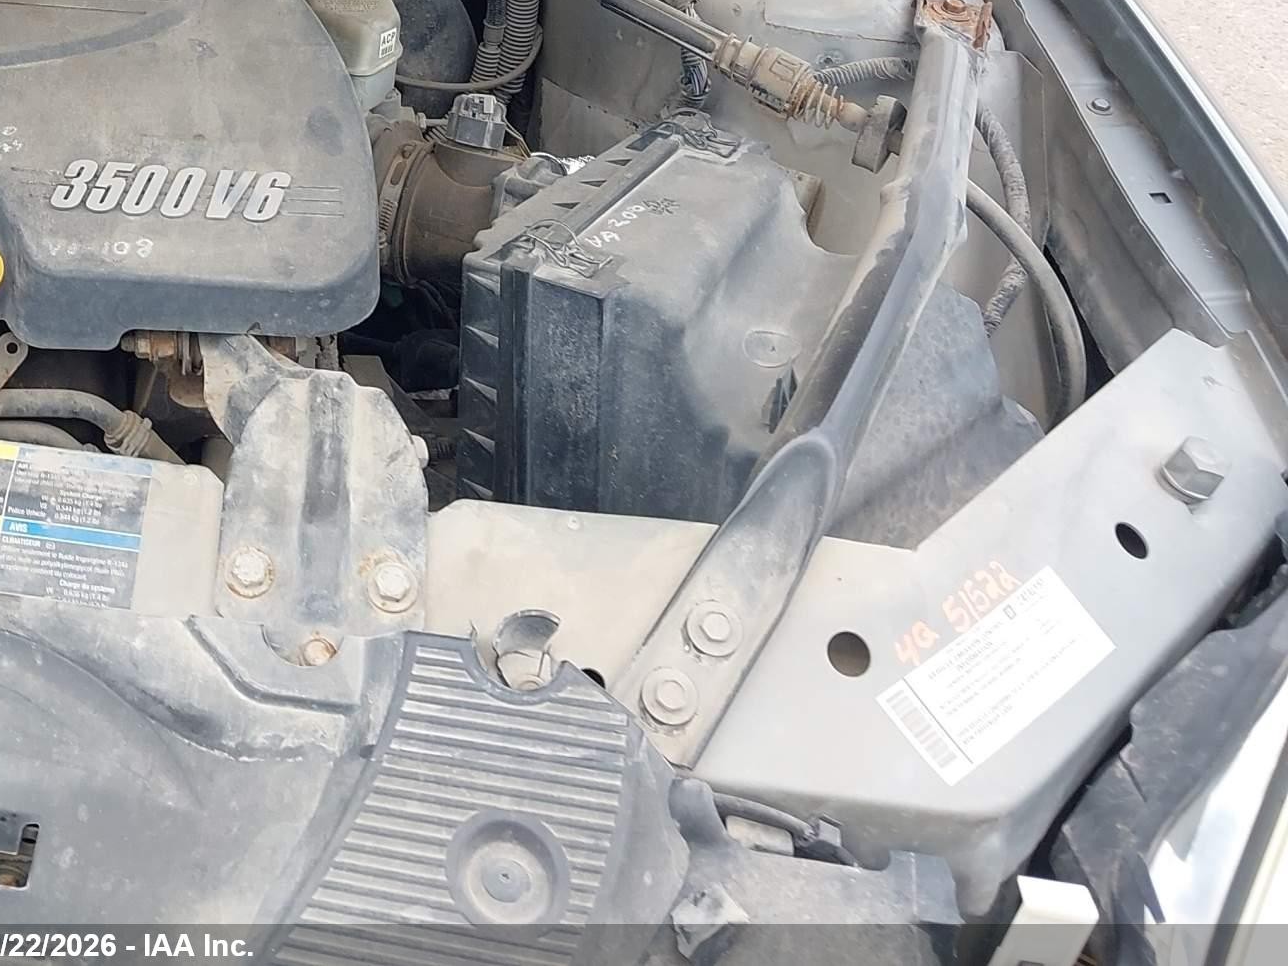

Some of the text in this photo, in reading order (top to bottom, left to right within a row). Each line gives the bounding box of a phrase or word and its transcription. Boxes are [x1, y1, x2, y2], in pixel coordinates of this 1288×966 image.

[50, 159, 292, 222] 3500 V6
[8, 521, 28, 532] AVIS
